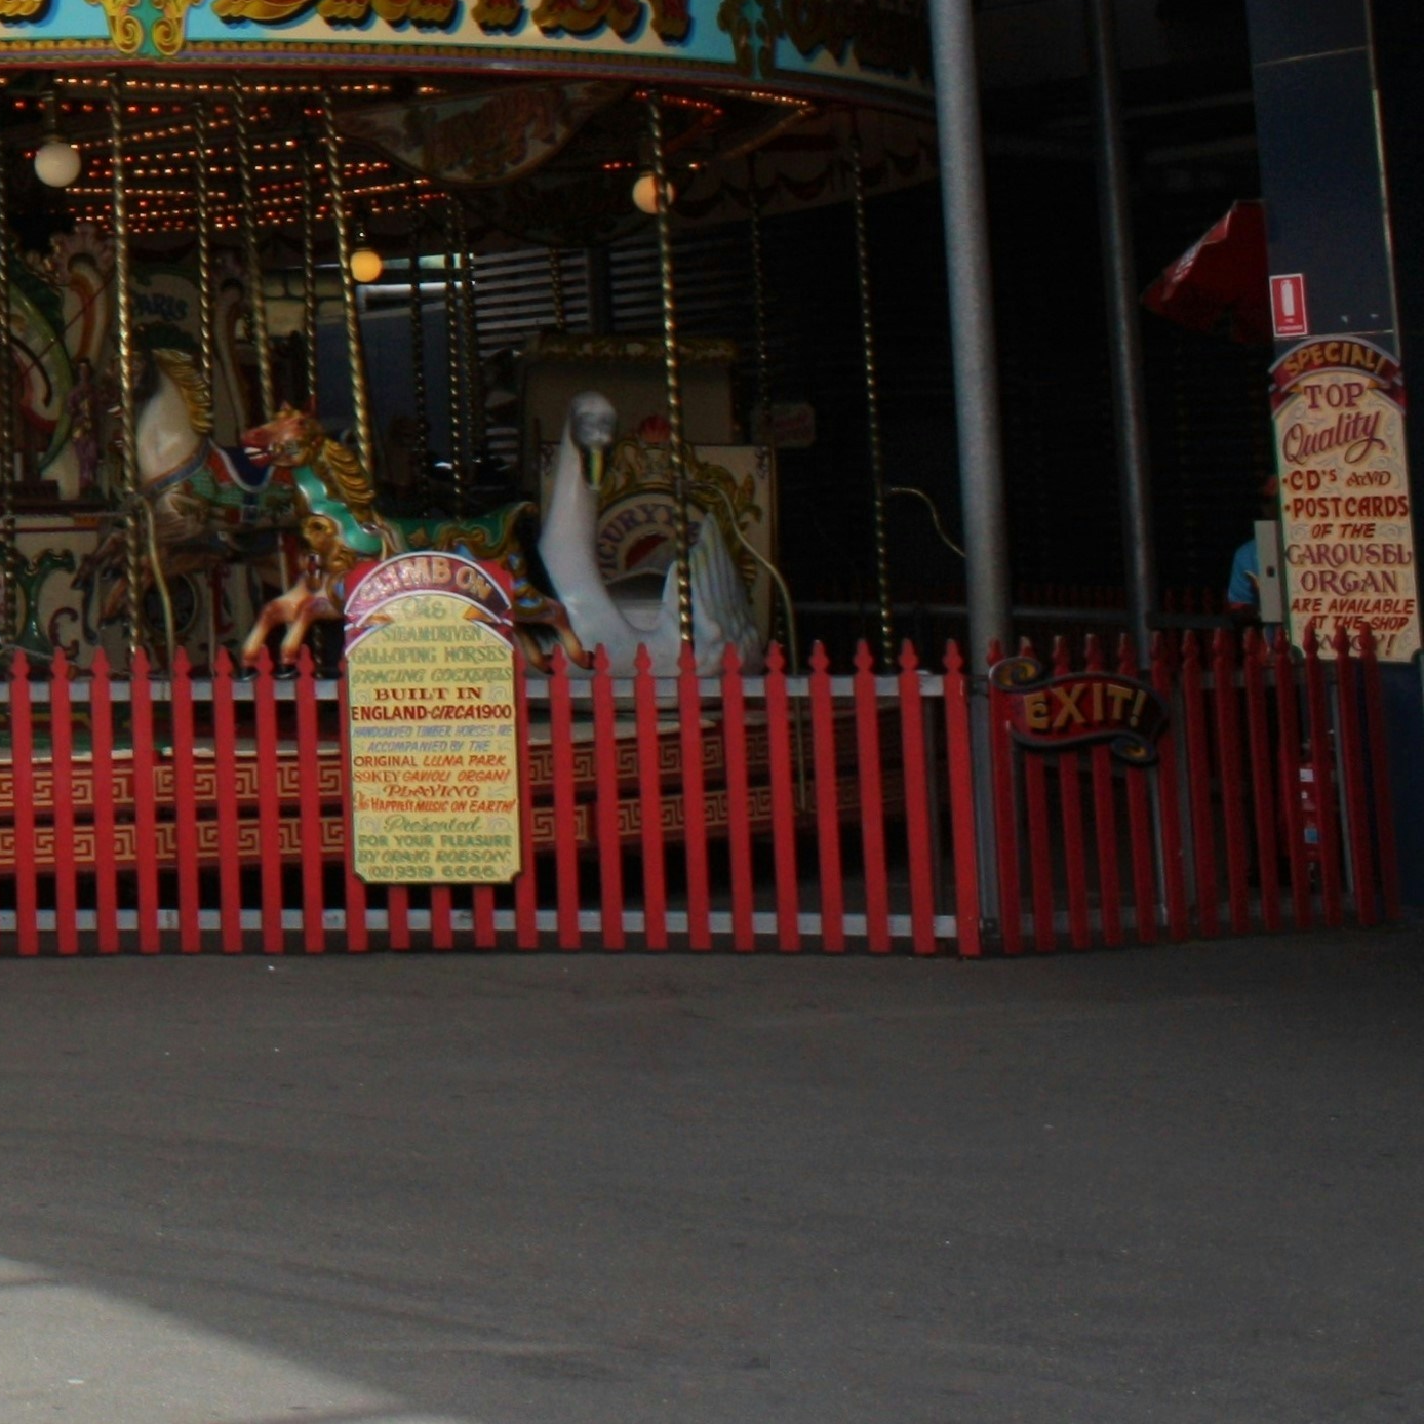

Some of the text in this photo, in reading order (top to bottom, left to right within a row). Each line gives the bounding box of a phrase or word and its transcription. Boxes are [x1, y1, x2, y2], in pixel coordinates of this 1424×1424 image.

[1285, 342, 1387, 377] SPECIAL!
[1304, 381, 1365, 410] TOP
[1282, 409, 1386, 464] Quality
[1311, 522, 1377, 539] OF THE
[1285, 543, 1413, 568] CAROUSEL
[358, 556, 493, 602] CLIMB ON
[1299, 569, 1399, 596] ORGAN
[1291, 597, 1416, 615] ARE AVAILABLE
[1370, 617, 1410, 632] SHOP
[352, 645, 508, 664] GALLOPING HORSES
[374, 687, 483, 701] BUILT IN
[1022, 682, 1148, 729] EXIT!
[353, 753, 507, 768] ORIGINAL LUNA PARK
[383, 784, 480, 798] PLAYING
[383, 814, 481, 833] Presented
[358, 834, 513, 848] FOR YOUR PLEASURE
